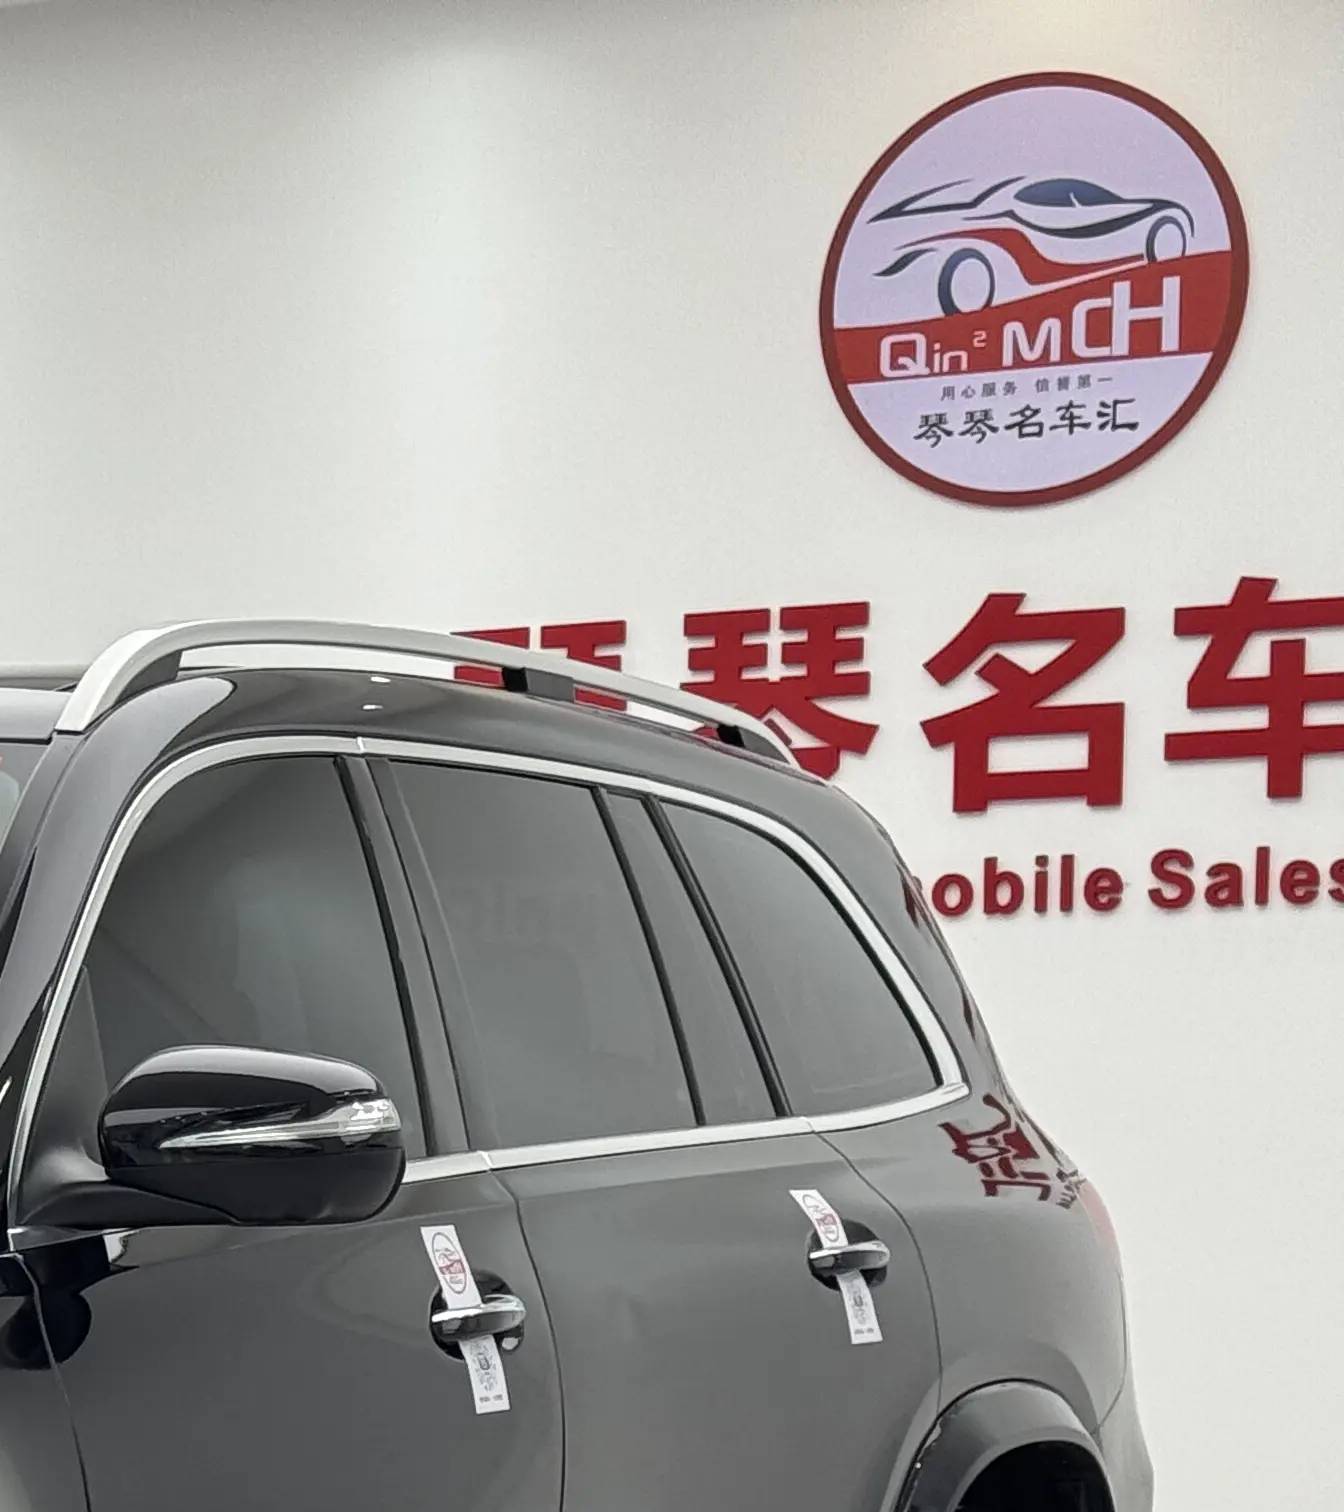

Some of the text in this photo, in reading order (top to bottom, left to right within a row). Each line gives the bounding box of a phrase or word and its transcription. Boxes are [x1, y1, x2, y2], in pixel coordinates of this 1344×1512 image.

[1002, 275, 1181, 369] MCH
[913, 398, 1139, 448] 琴琴名车汇
[912, 855, 1124, 918] obile
